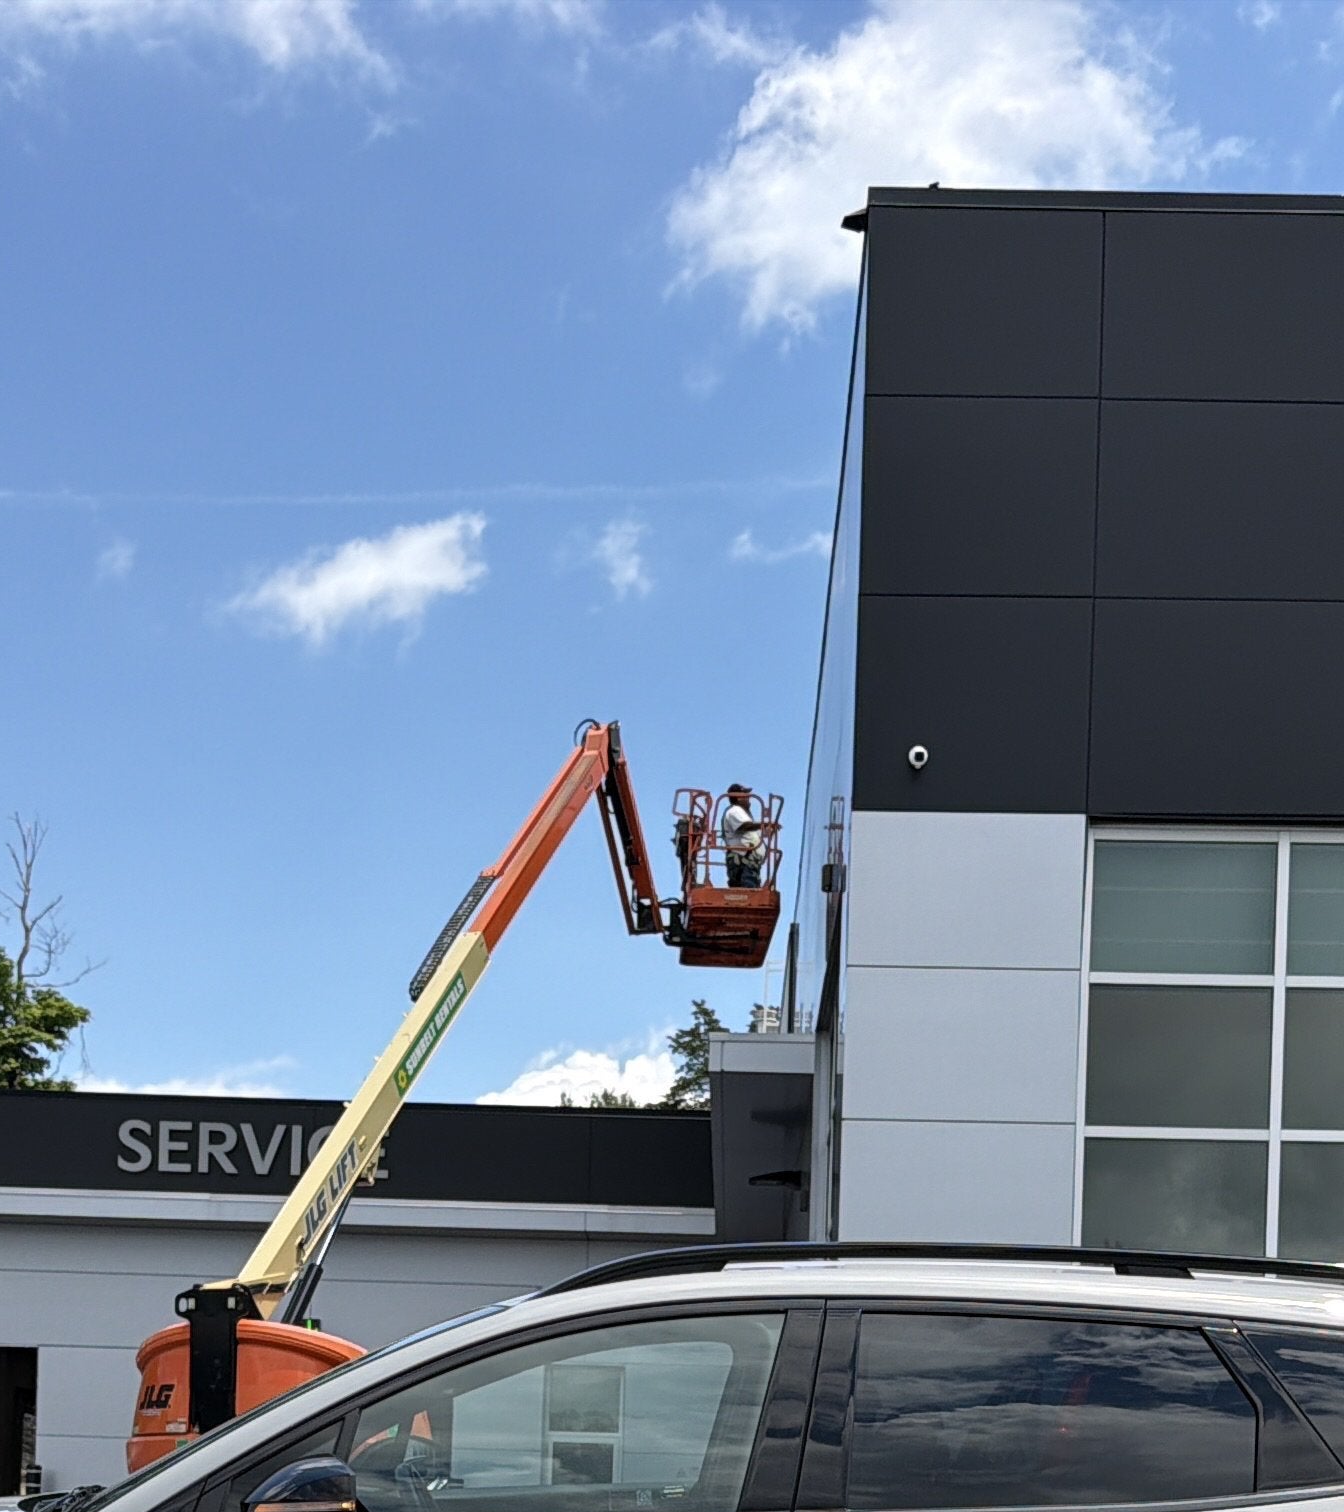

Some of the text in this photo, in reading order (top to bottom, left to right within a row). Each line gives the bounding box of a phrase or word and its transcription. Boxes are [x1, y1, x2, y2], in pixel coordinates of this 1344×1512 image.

[117, 1119, 389, 1179] SERVI
[303, 1140, 357, 1244] JLG LIFT
[139, 1384, 175, 1410] JLG
